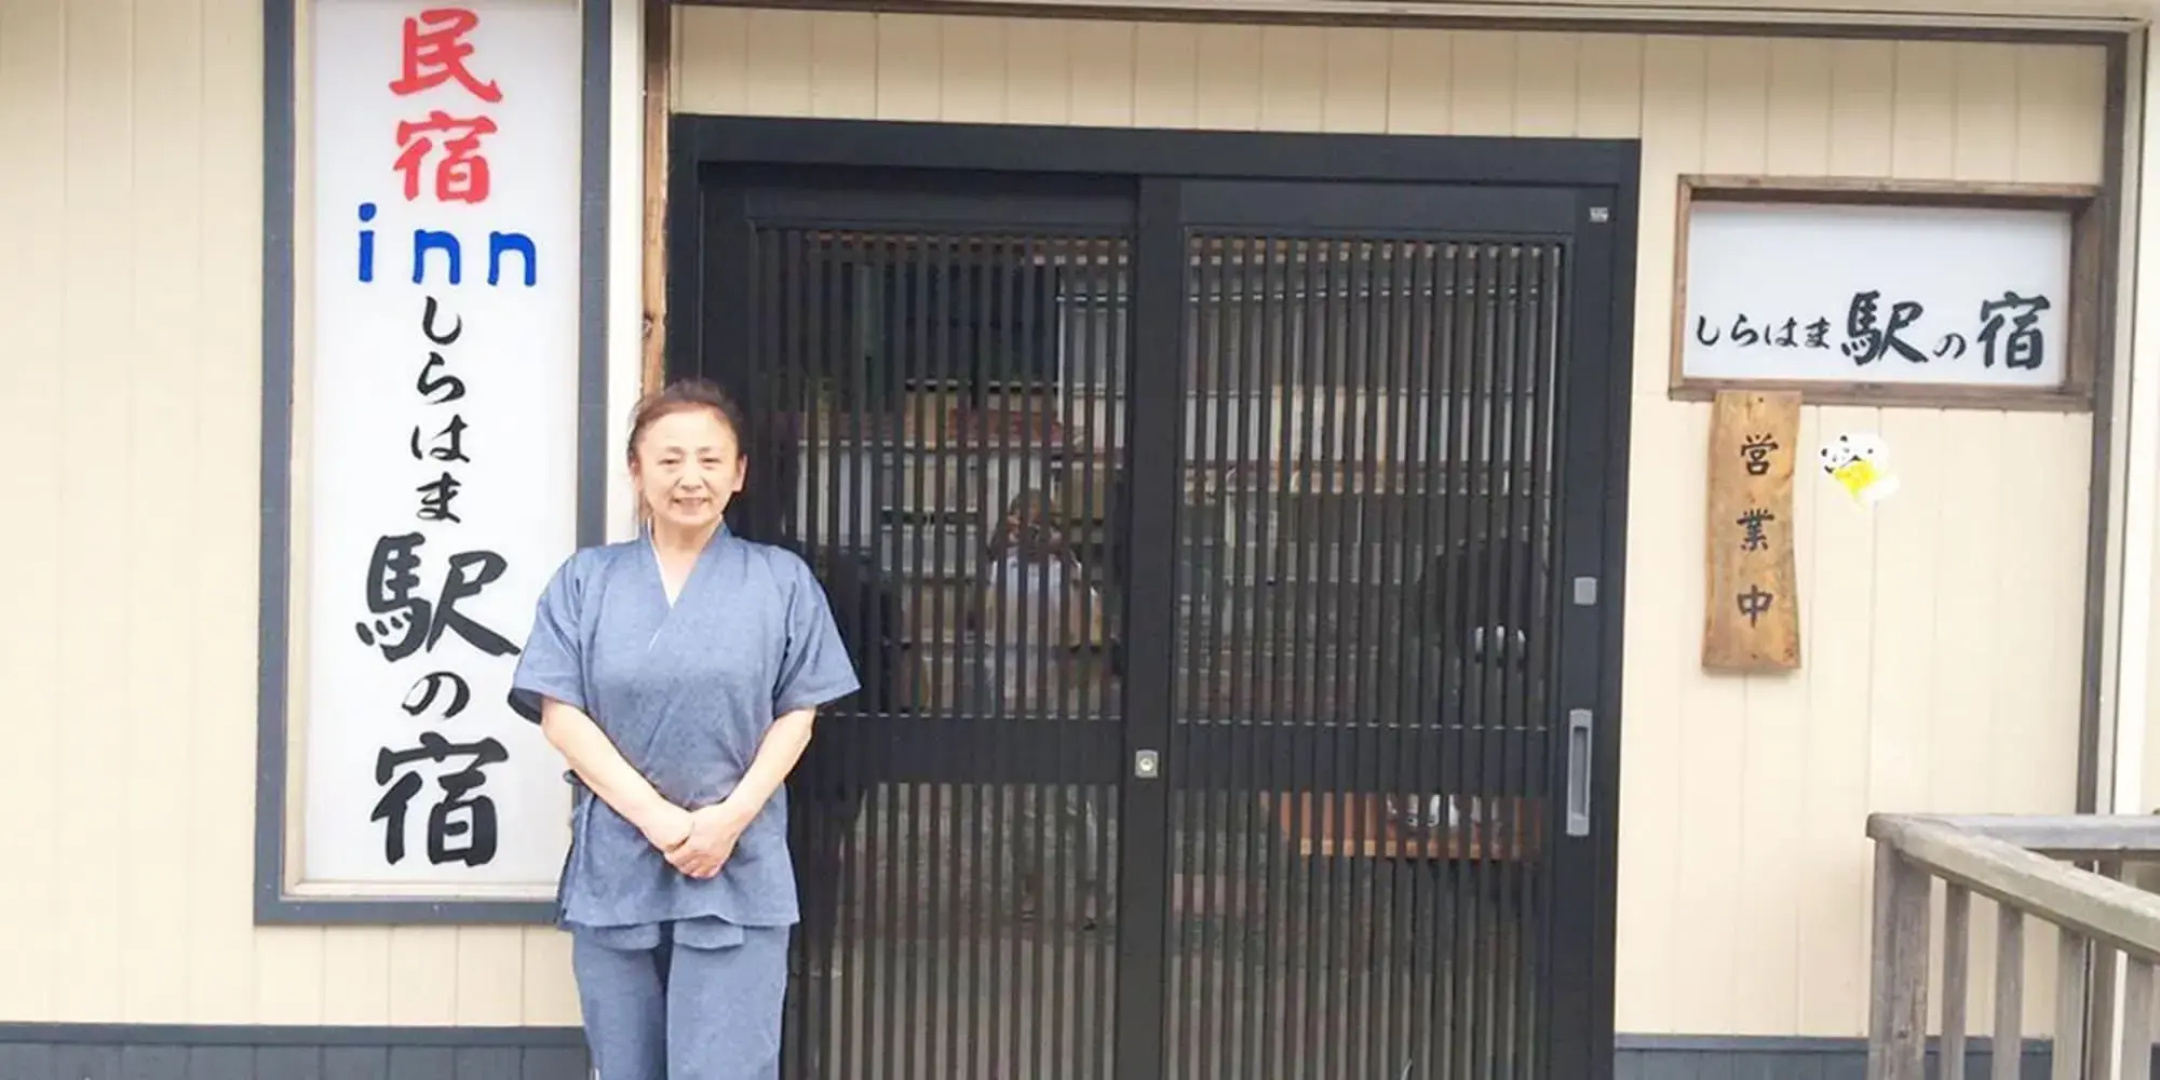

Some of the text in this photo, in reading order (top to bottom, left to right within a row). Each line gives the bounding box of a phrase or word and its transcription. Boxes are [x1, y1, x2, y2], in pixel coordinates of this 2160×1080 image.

[388, 7, 503, 205] 民宿
[357, 202, 538, 287] inn
[1695, 289, 2051, 371] しらはま駅の宿
[355, 296, 521, 867] しらはま駅の宿
[1736, 433, 1780, 629] 営業中
